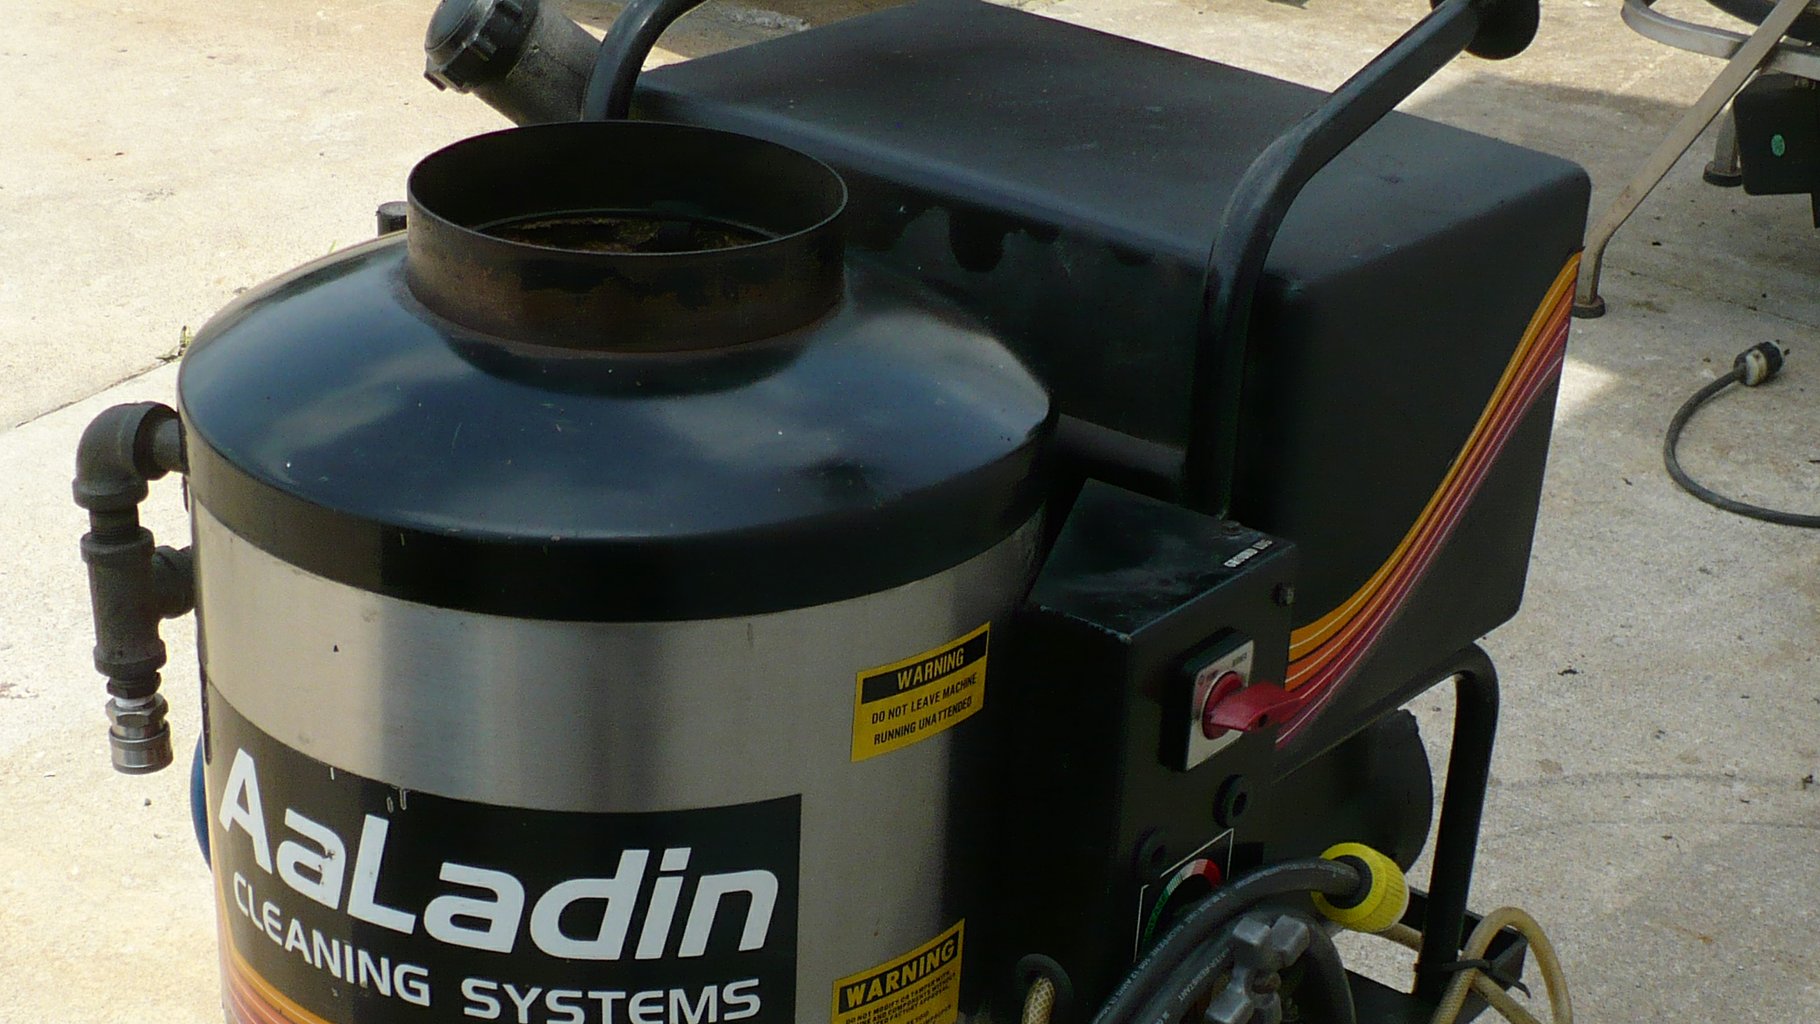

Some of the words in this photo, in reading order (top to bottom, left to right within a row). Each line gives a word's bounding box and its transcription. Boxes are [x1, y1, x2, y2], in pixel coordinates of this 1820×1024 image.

[872, 711, 885, 724] DO
[888, 703, 908, 720] NOT
[911, 691, 940, 713] LEAVE
[943, 672, 977, 699] MACHINE
[897, 648, 964, 690] WARNING
[874, 721, 916, 745] RUNNING
[918, 696, 972, 730] UNATTENDED
[219, 747, 779, 960] AaLadin
[233, 871, 431, 1007] CLEANING
[847, 940, 955, 1008] WARNING
